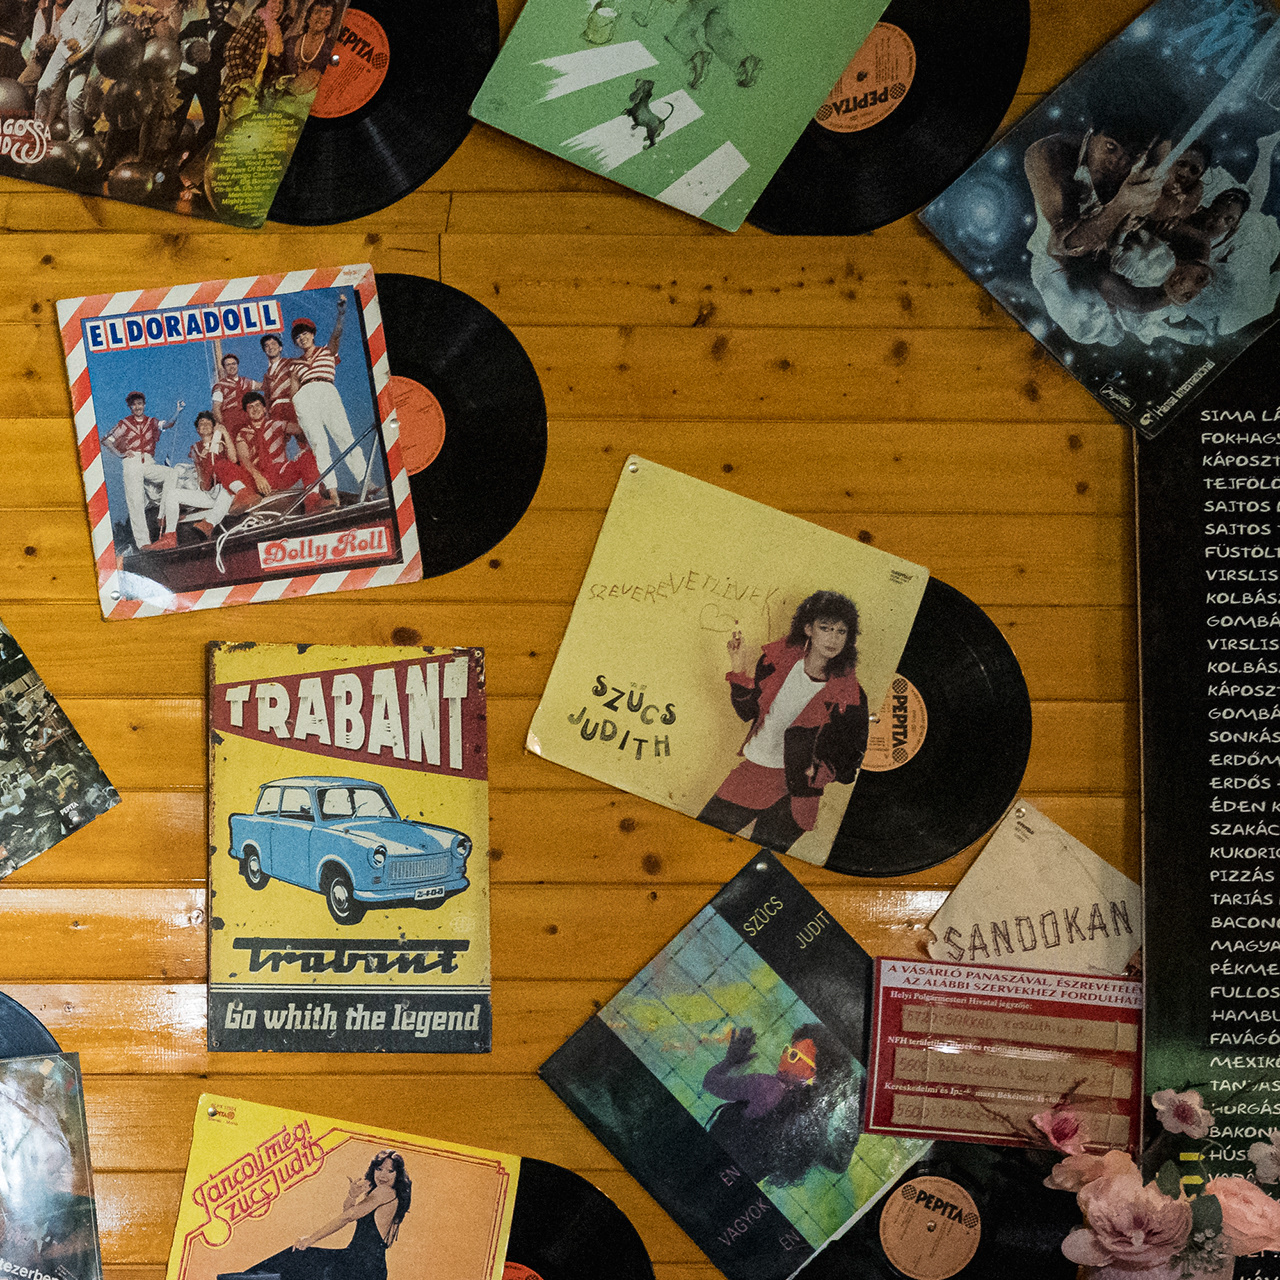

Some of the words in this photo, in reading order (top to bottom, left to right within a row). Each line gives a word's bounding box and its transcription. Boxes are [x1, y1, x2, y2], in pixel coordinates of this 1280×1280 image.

[340, 24, 374, 65] EPITA
[832, 86, 890, 116] PEPITA
[89, 303, 279, 351] ELDORADOLL
[1201, 410, 1255, 422] SIMA
[1204, 500, 1271, 513] SAJTOS
[1204, 523, 1271, 535] SAJTOS
[263, 535, 328, 565] Dolly
[330, 527, 385, 558] Roll
[1205, 569, 1278, 582] VIRSLIS
[1206, 588, 1280, 605] KOLBÁS
[1206, 611, 1280, 629] GOMBÁ
[1207, 638, 1280, 651] VIRSLIS
[1207, 658, 1280, 674] KOLBÁS
[1207, 681, 1280, 697] KÁPOSZ
[225, 656, 469, 770] TRABANT
[1208, 704, 1280, 721] GOMBÁ
[892, 693, 908, 751] PEPITA
[567, 706, 671, 761] JUDITH
[1208, 727, 1280, 743] SONKÁS
[1209, 751, 1280, 767] ERDŐM
[1209, 774, 1271, 789] ERDŐS
[1209, 796, 1266, 813] ÉDEN
[1209, 820, 1280, 836] SZAKÁC
[1210, 866, 1275, 882] PIZZÁS
[1210, 889, 1273, 906] TARJÁS
[795, 909, 830, 950] JUDIT
[943, 900, 1133, 962] SANDOKAN
[1210, 940, 1280, 953] MAGYA
[232, 937, 471, 974] Trabant
[1210, 958, 1280, 976] PÉKME
[887, 965, 897, 973] A
[902, 965, 962, 979] VÁSÁRLÓ
[965, 971, 1053, 988] PANASZÁVAL,
[902, 977, 920, 986] AZ
[923, 978, 970, 990] ALÁBBI
[973, 983, 1057, 998] SZERVEKHEZ
[1210, 986, 1280, 998] FULLOS
[890, 990, 912, 1000] Helyi
[969, 998, 997, 1007] Hivatal
[225, 1002, 256, 1030] Go
[263, 1004, 337, 1031] whith
[345, 1004, 385, 1031] the
[391, 1004, 480, 1038] legend
[887, 1036, 907, 1045] NFH
[1210, 1029, 1280, 1045] FAVÁGÓ
[884, 1082, 938, 1094] Kereskedelmi
[940, 1086, 948, 1094] és
[1209, 1145, 1248, 1161] HÚS
[916, 1190, 964, 1224] PEPITA
[718, 1197, 770, 1249] VAGYOK
